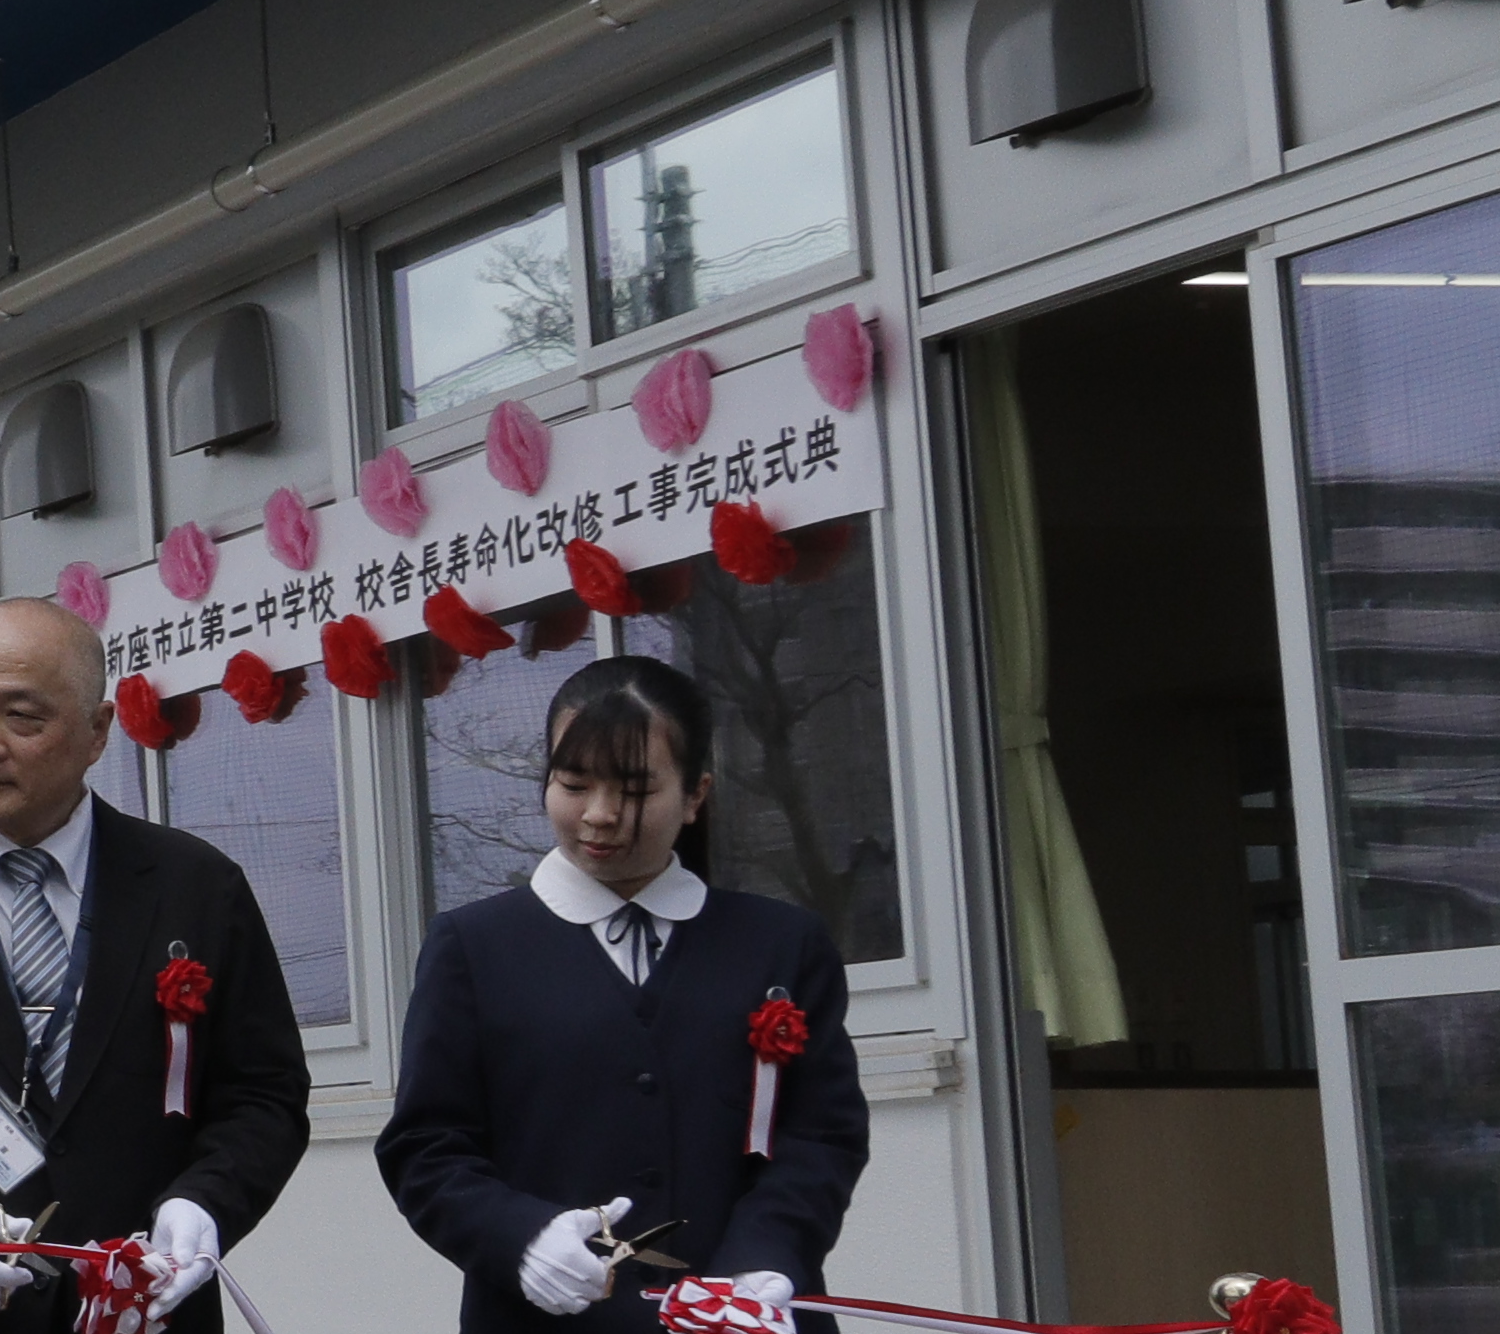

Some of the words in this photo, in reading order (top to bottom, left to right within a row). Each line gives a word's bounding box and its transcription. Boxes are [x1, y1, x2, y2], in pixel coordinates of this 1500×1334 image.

[106, 572, 337, 677] 新座市立第二中学校
[354, 415, 840, 612] 校舎長寿命化改修工事完成式典
